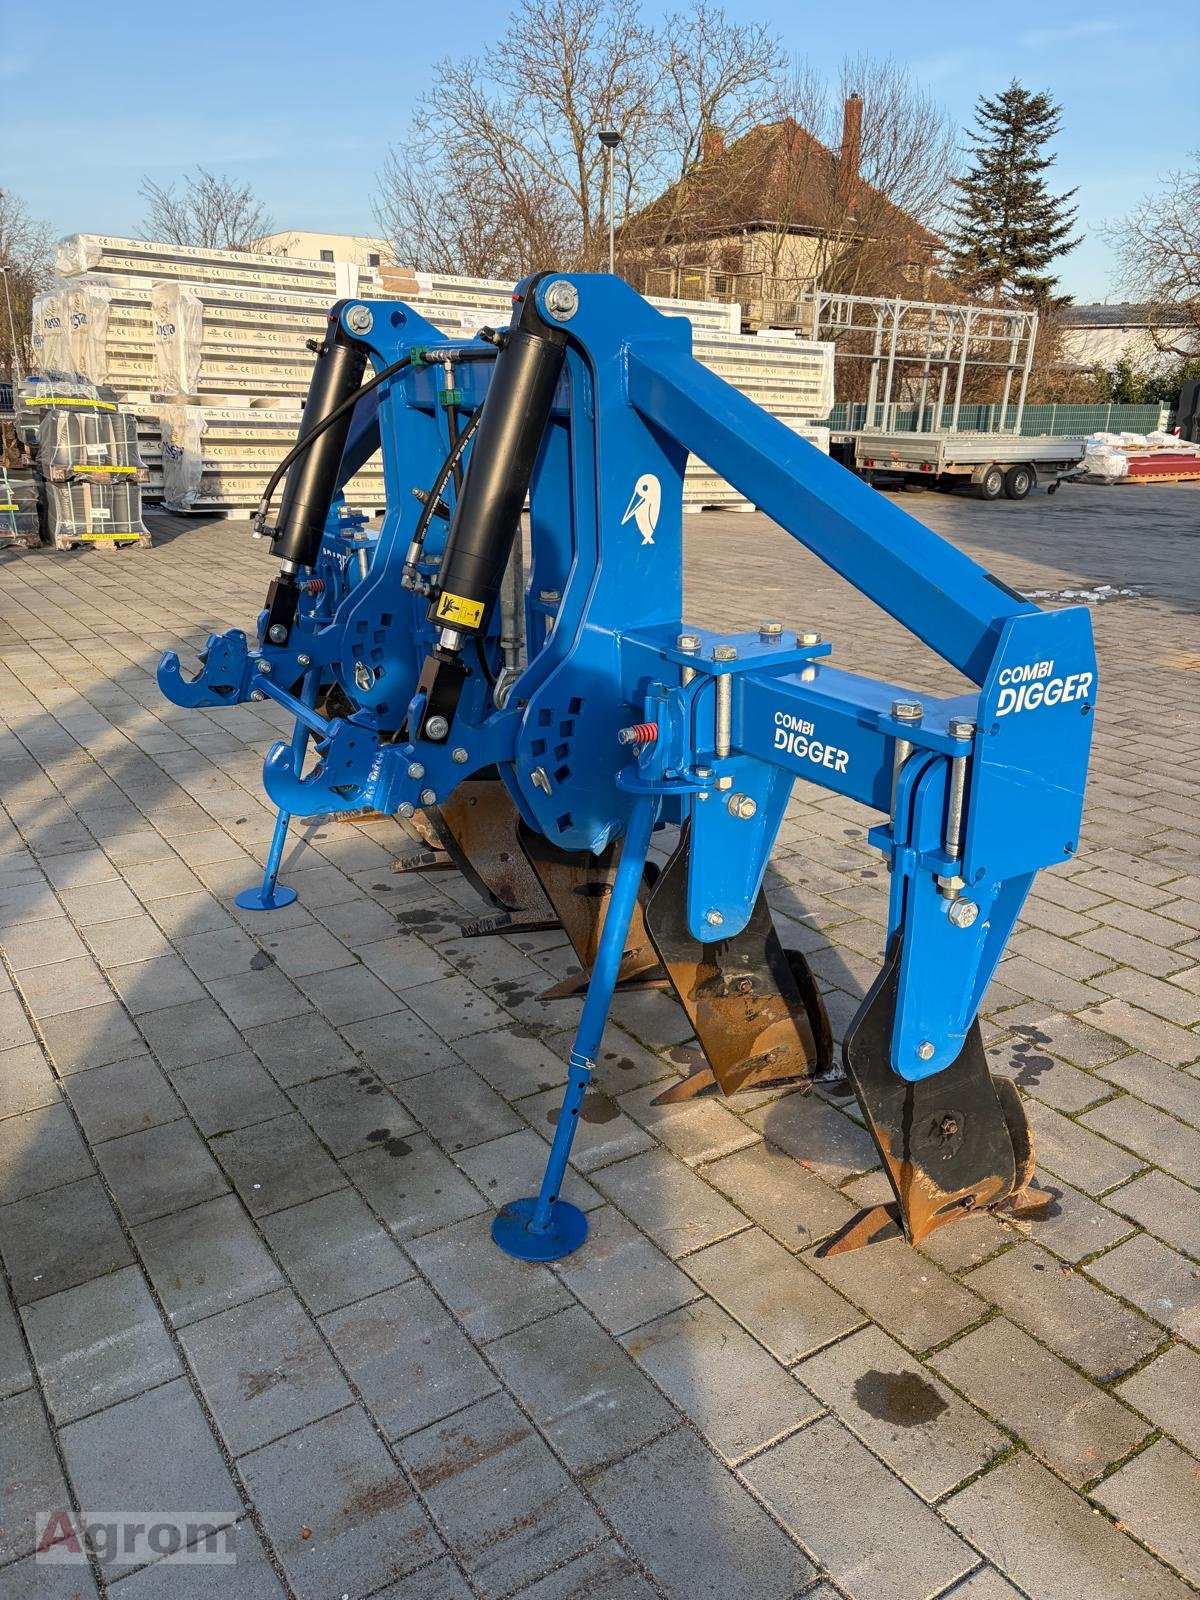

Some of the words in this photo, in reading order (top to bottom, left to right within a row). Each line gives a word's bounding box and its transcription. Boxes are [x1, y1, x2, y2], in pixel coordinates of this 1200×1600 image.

[999, 660, 1054, 686] COMBI
[995, 671, 1093, 717] DIGGER
[774, 711, 815, 737] COMBI
[774, 727, 849, 774] DIGGER
